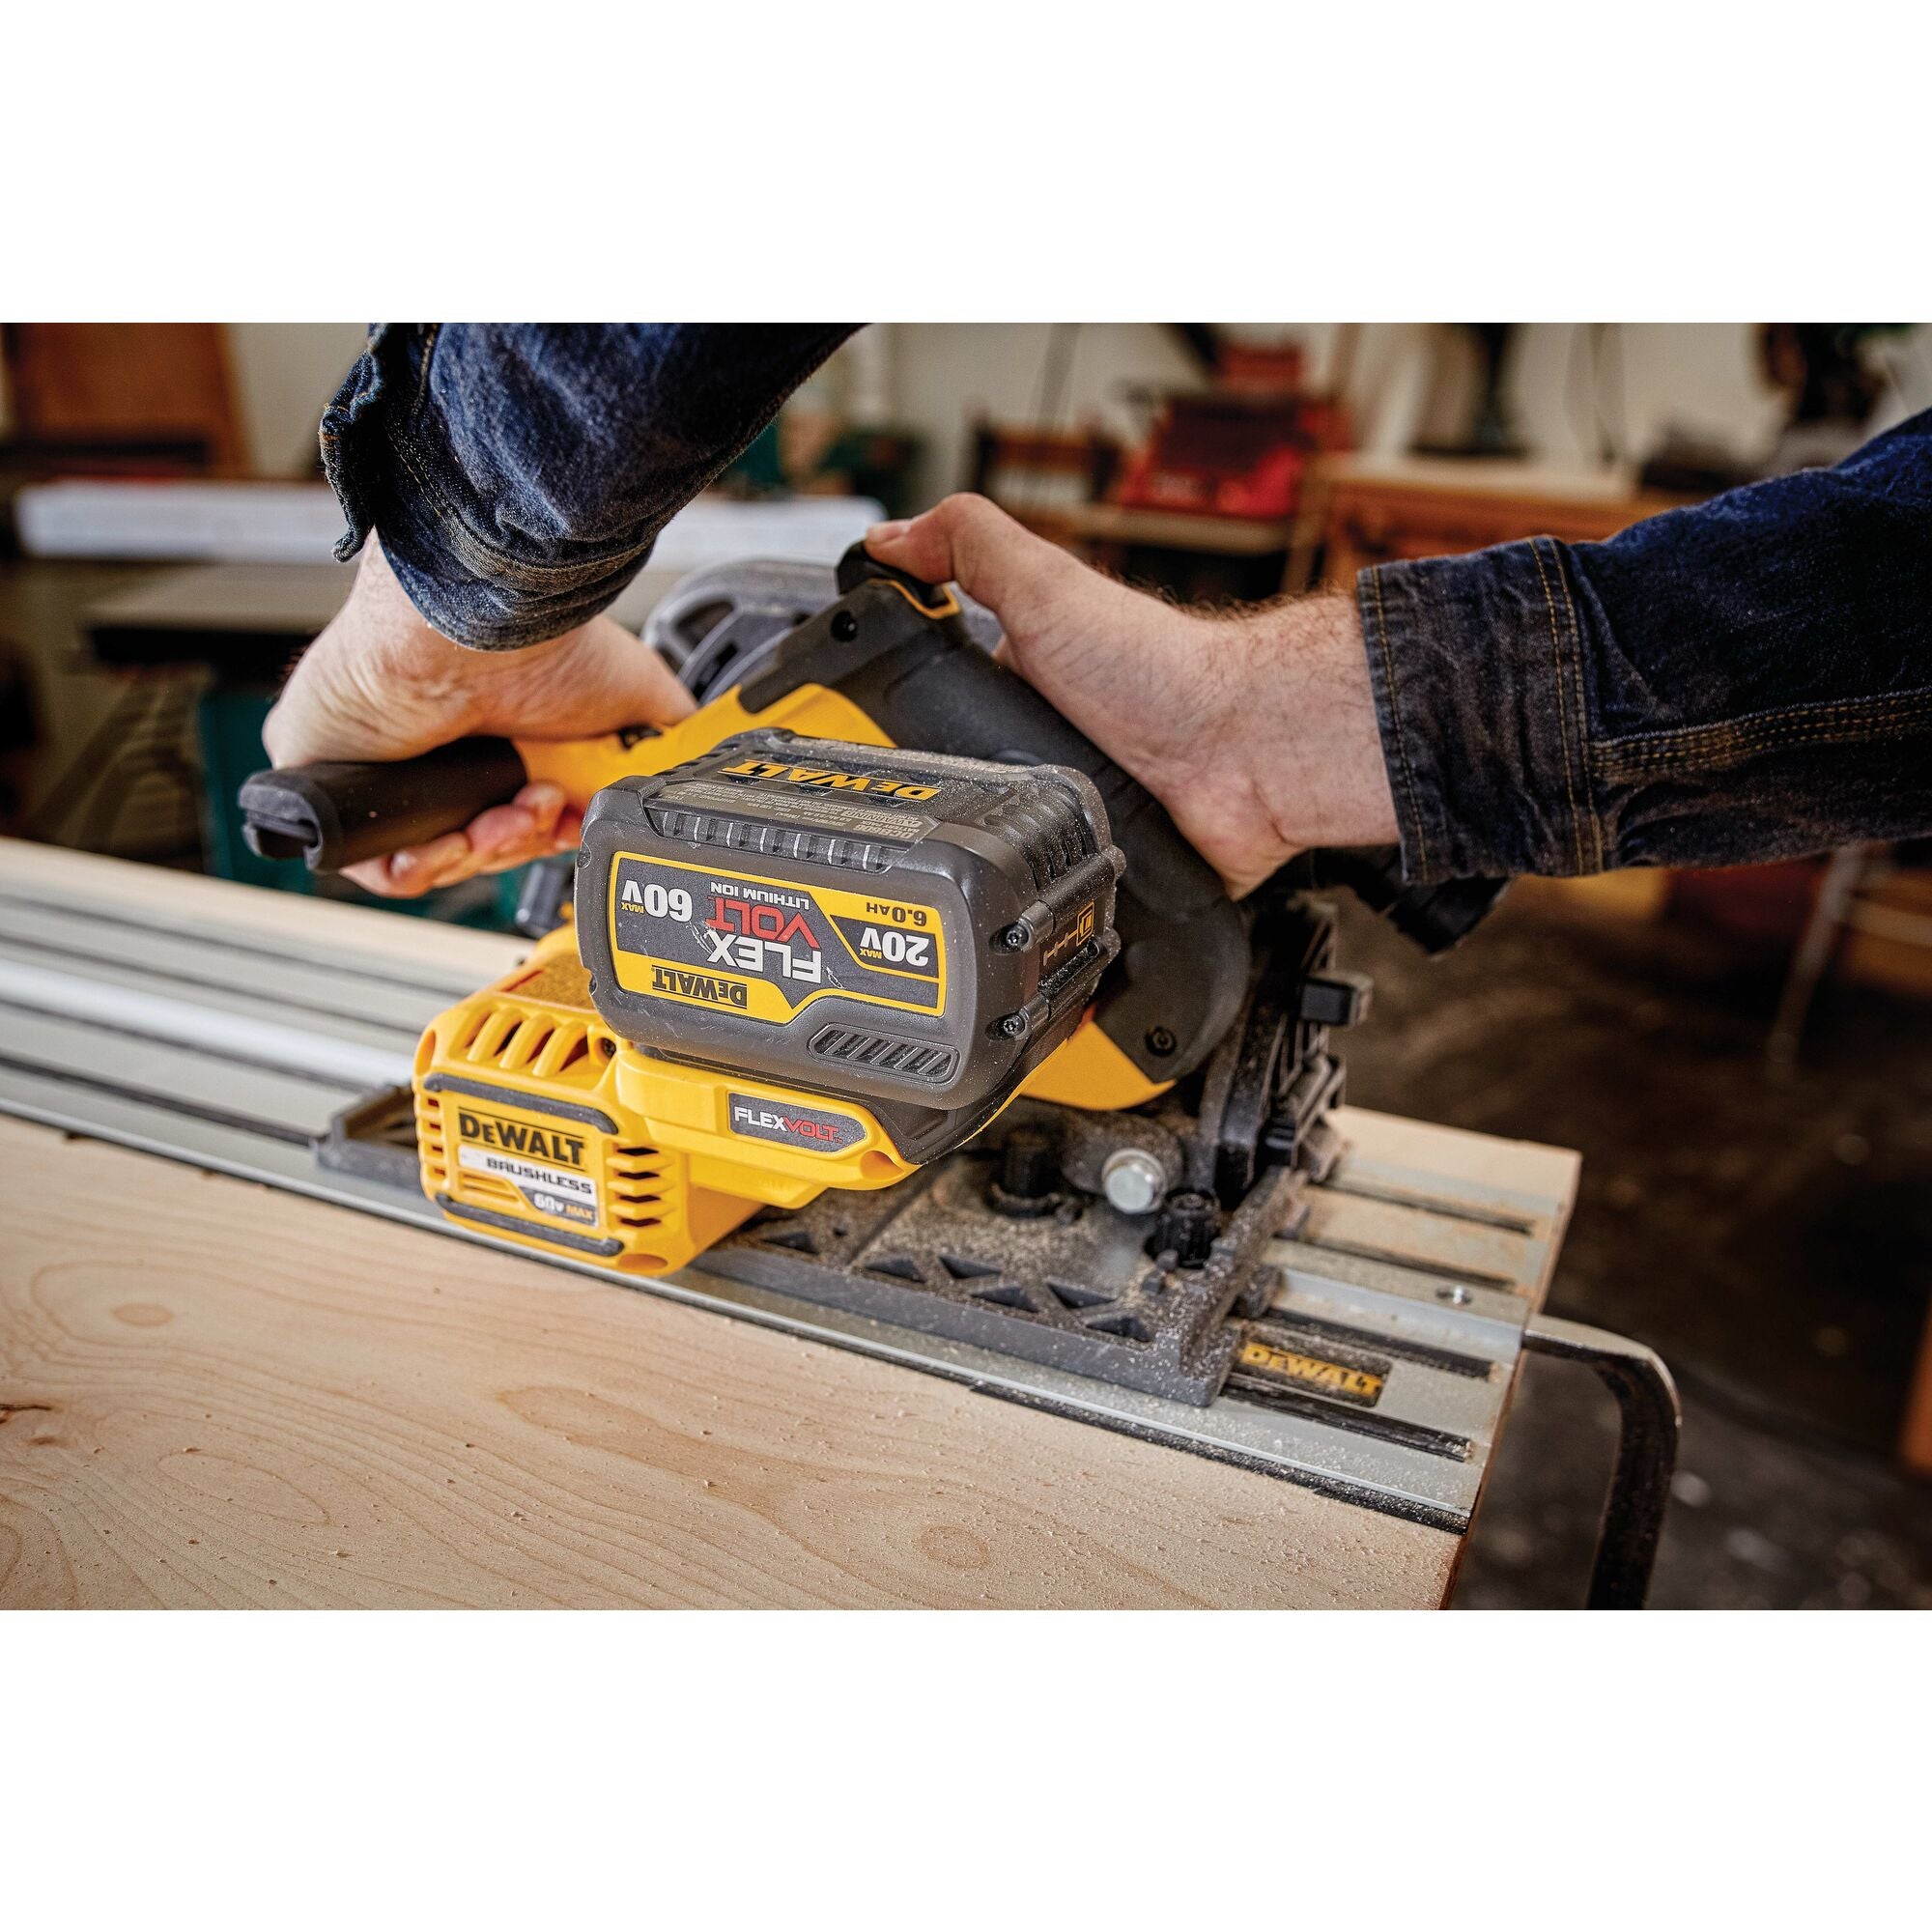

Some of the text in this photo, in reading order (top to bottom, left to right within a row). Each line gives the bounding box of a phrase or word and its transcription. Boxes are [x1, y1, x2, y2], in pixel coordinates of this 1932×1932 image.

[722, 761, 942, 801] DEWALT
[621, 902, 645, 915] MAX
[710, 881, 810, 911] LITHIUM ION
[705, 896, 821, 951] VOLT
[706, 928, 822, 984] FLEX
[859, 948, 883, 959] MAX
[652, 967, 748, 1008] DEWALT
[459, 1112, 584, 1166] DEWALT
[486, 1156, 592, 1195] BRUSHLESS
[565, 1204, 594, 1221] MAX
